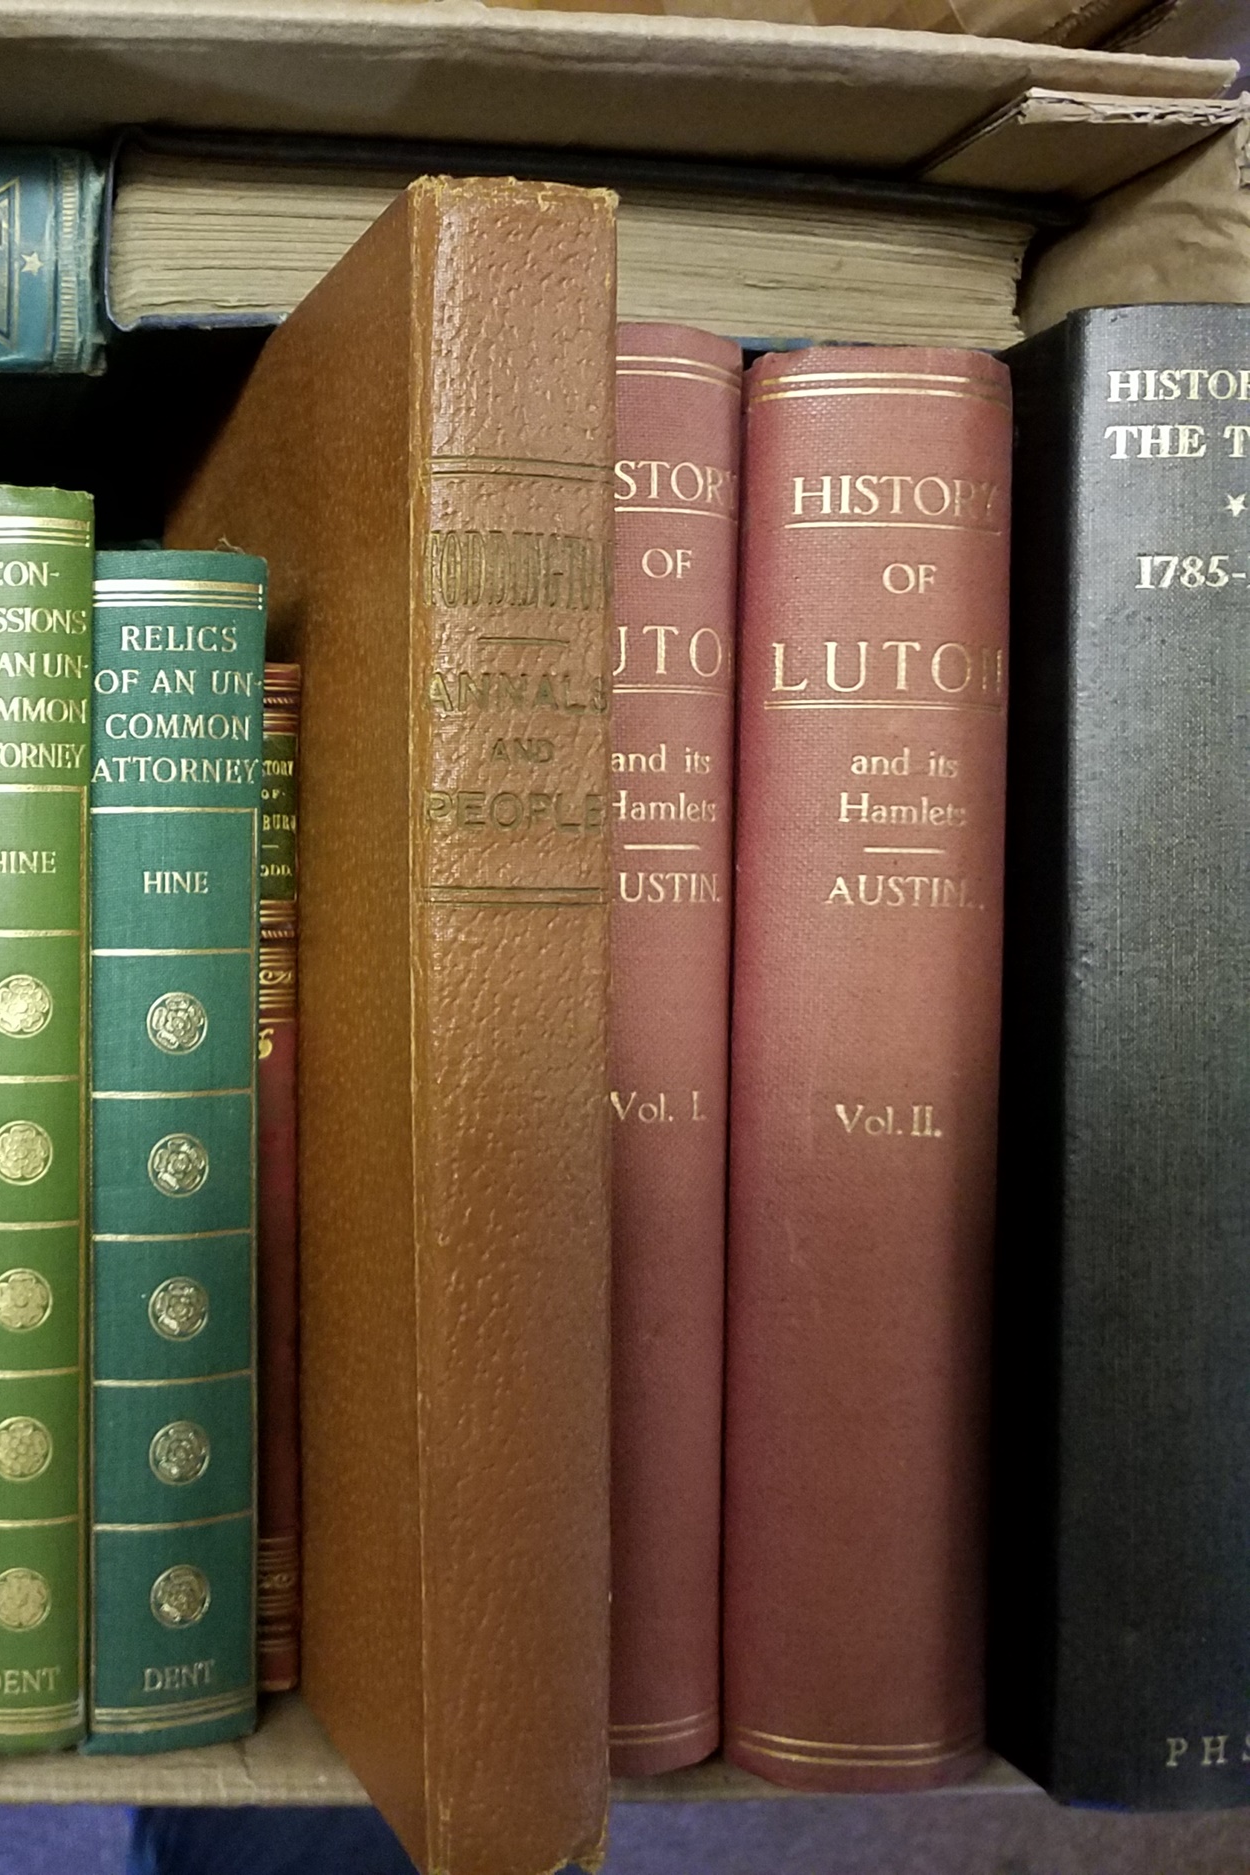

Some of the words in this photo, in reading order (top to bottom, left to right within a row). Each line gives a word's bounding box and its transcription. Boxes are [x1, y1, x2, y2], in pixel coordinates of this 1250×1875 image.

[1104, 425, 1207, 459] THE
[792, 475, 999, 518] HISTORY
[641, 548, 692, 579] OF
[882, 563, 938, 594] OF
[1135, 554, 1250, 589] 1785-
[120, 625, 238, 653] RELICS
[771, 641, 1003, 693] LUTON
[94, 669, 142, 694] OF
[150, 669, 197, 696] AN
[211, 669, 262, 697] UN-
[428, 670, 609, 713] ANNALS
[105, 713, 252, 741] COMMON
[489, 737, 554, 763] AND
[611, 743, 666, 772] and
[685, 746, 711, 774] its
[851, 747, 910, 776] and
[929, 751, 961, 778] its
[91, 757, 259, 784] ATTORNEY
[424, 791, 605, 831] PEOPLE
[838, 791, 968, 827] Hamlets
[143, 871, 209, 895] HINE
[611, 871, 720, 903] USTIN.
[610, 1091, 673, 1122] Vol.
[835, 1103, 903, 1136] Vol.
[910, 1105, 943, 1138] II.
[143, 1660, 213, 1692] DENT
